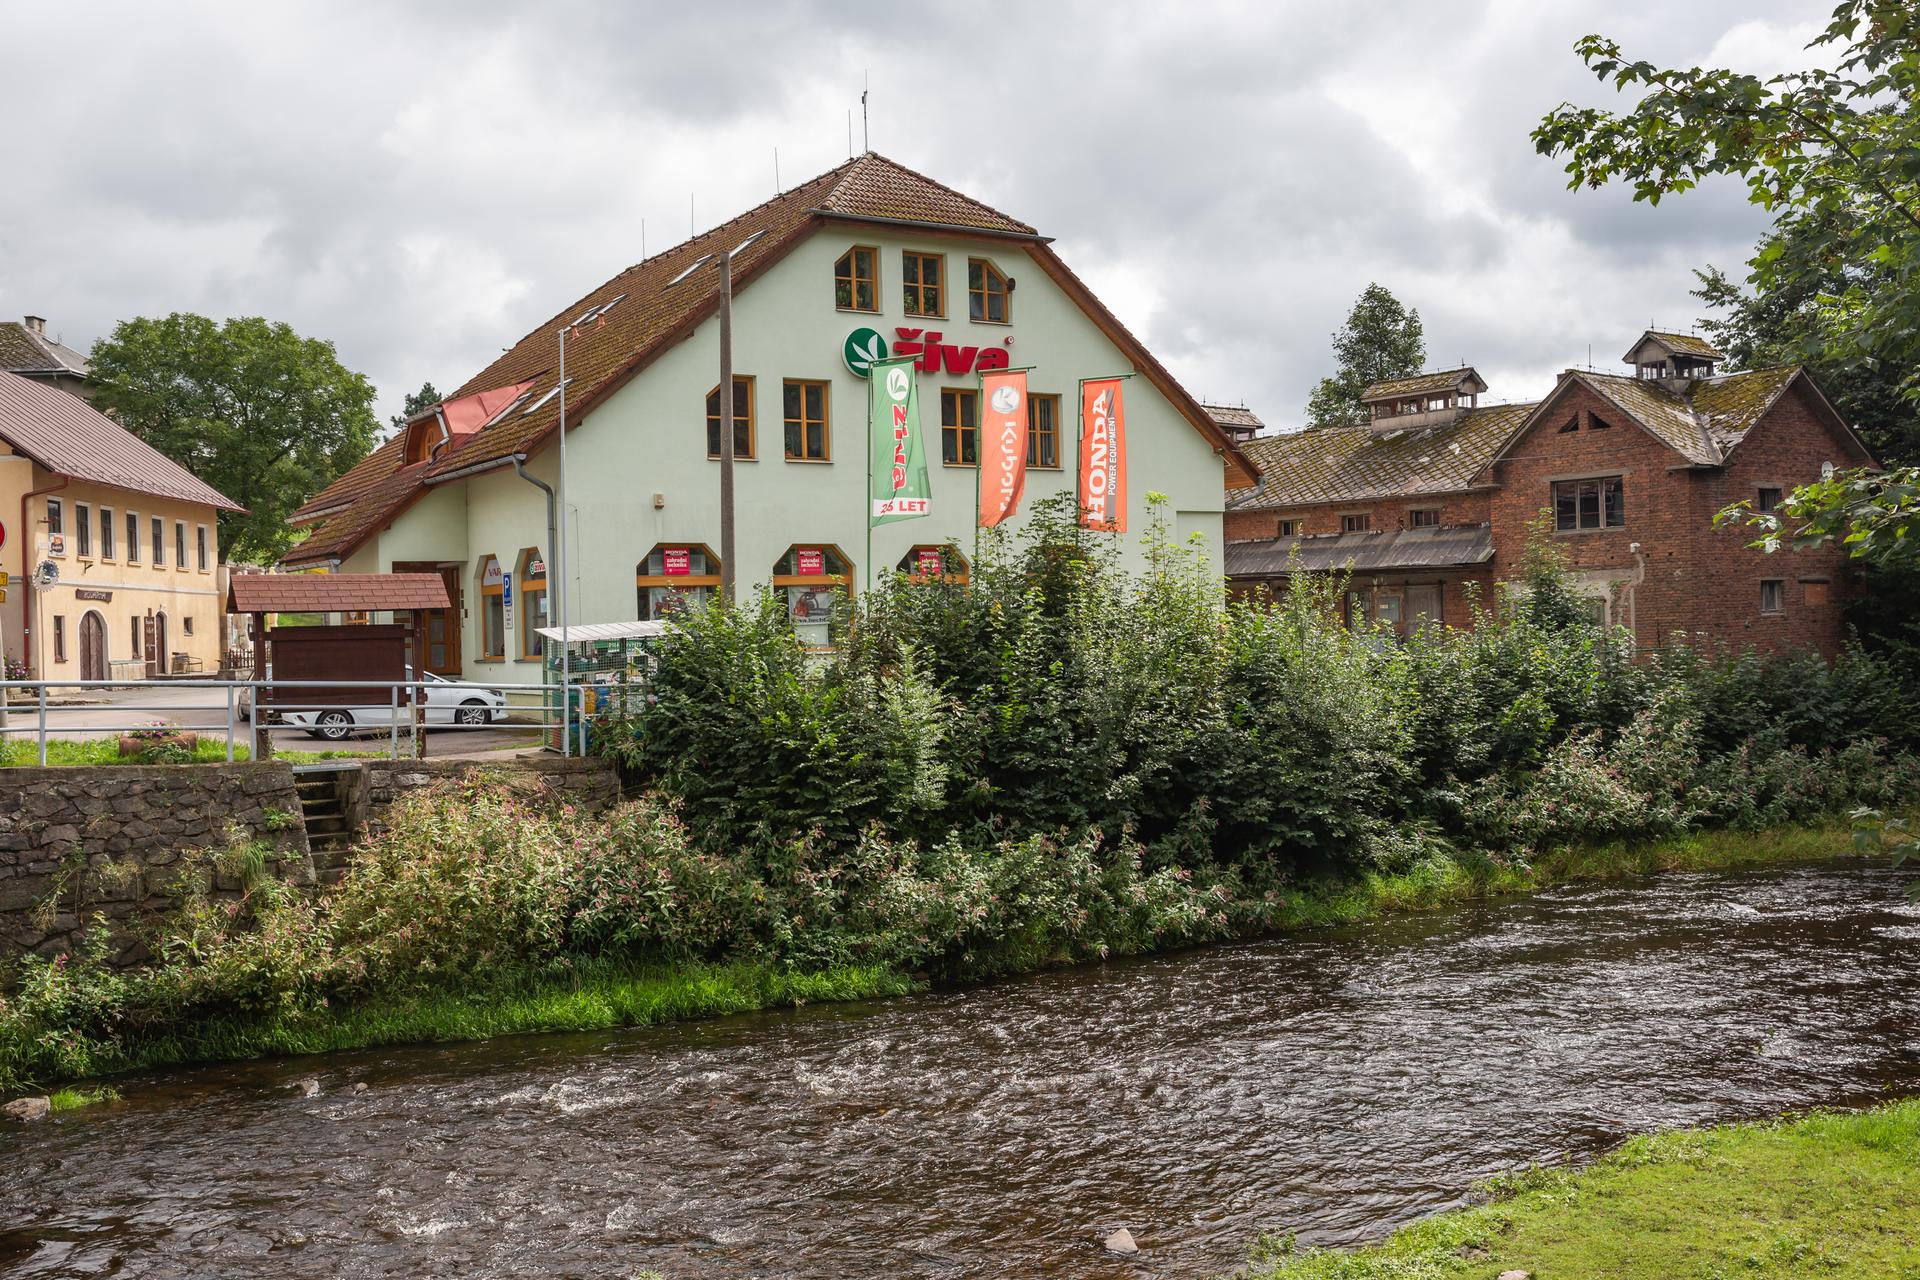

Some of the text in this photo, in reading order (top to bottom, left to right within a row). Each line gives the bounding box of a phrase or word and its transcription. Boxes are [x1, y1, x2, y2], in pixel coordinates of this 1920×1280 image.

[893, 328, 1010, 374] živa
[1086, 388, 1108, 523] HONDA
[1107, 416, 1118, 495] POWER EQUIPMENT
[899, 500, 926, 512] LET
[505, 577, 510, 595] P
